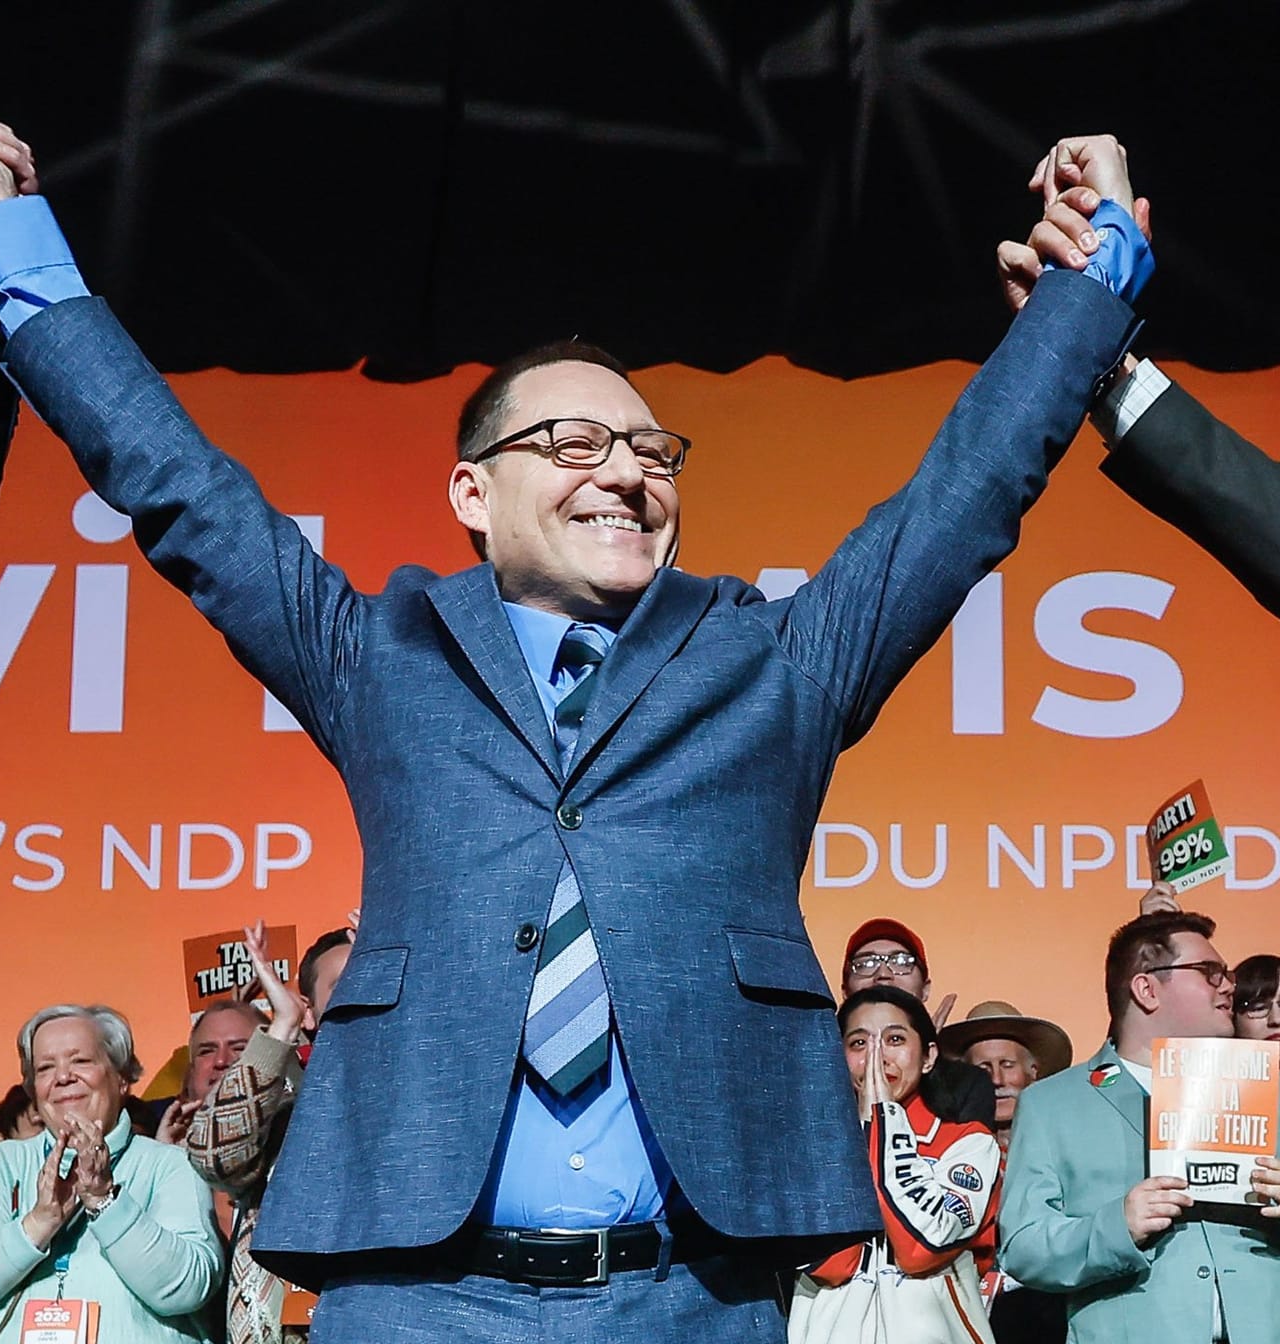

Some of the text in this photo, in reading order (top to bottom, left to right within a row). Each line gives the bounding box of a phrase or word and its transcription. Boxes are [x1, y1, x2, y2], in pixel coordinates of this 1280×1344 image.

[101, 823, 312, 891] NDP
[814, 824, 947, 888] DU
[1160, 828, 1213, 872] 99%
[1181, 876, 1196, 887] DU
[220, 941, 252, 965] TA
[197, 959, 289, 994] THE RH
[1159, 1048, 1176, 1078] LE
[1221, 1082, 1240, 1112] LA
[1223, 1114, 1269, 1147] TENTE
[34, 1311, 71, 1323] 2026
